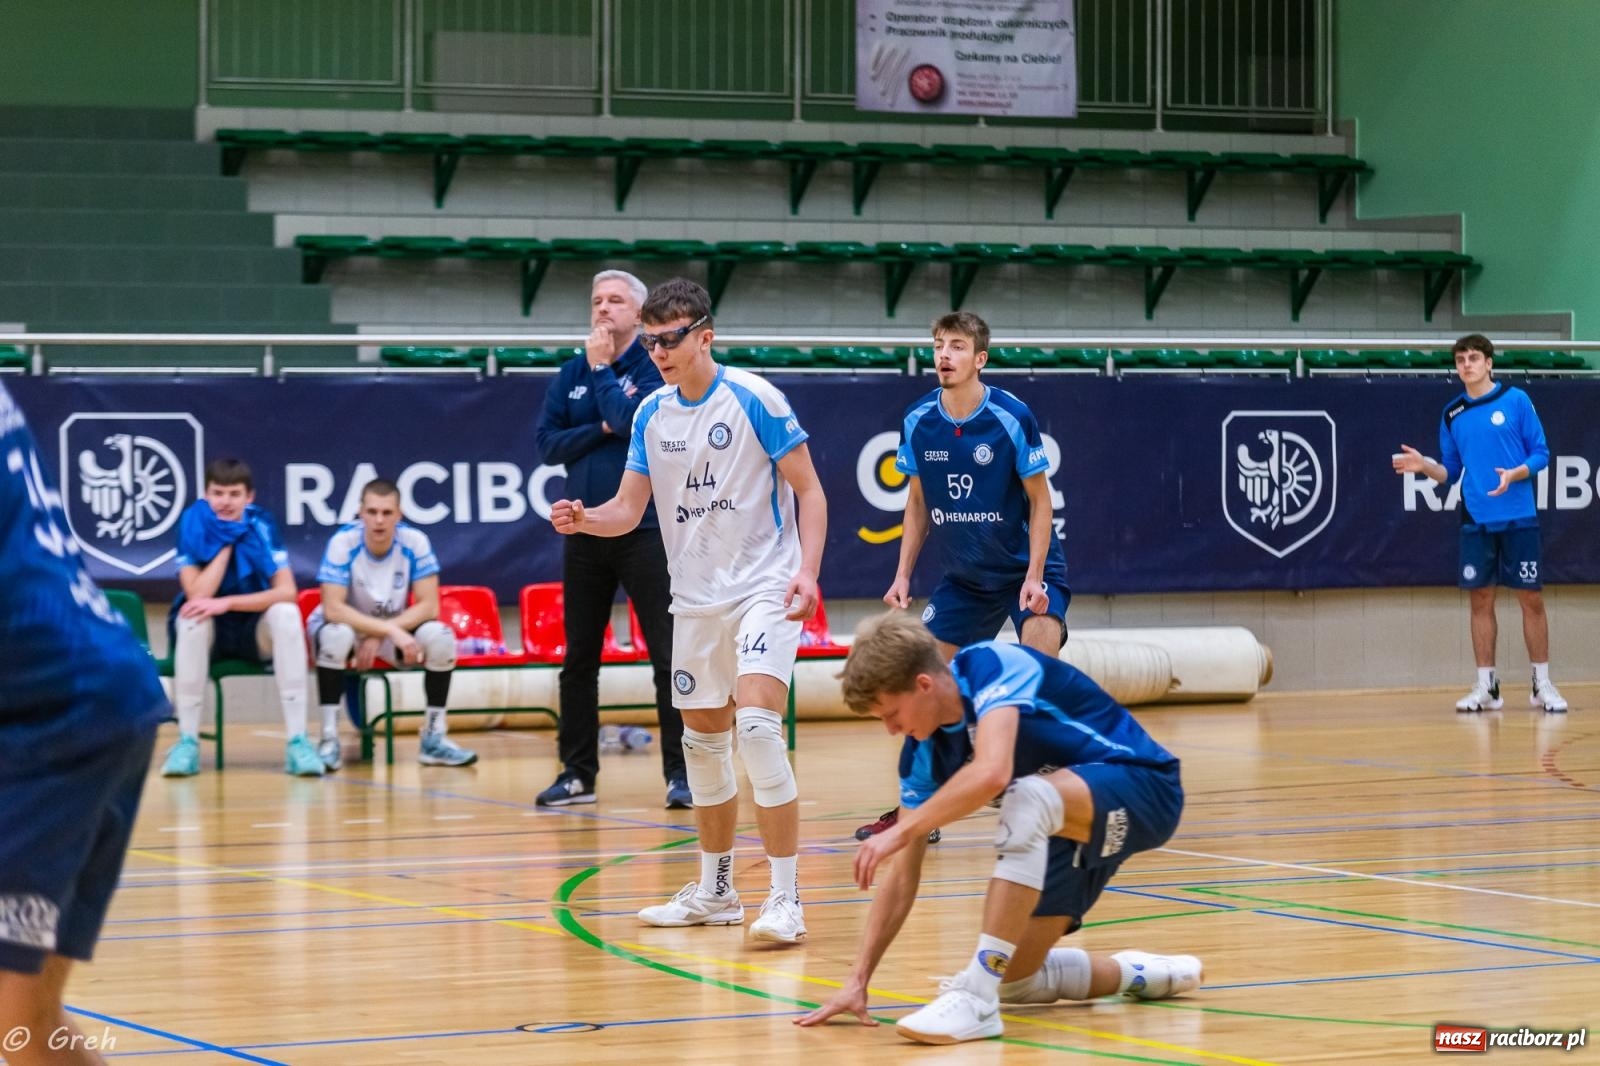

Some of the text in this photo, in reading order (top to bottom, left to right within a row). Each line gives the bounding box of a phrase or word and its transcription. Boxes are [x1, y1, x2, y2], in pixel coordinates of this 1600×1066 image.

[686, 461, 717, 492] 44
[947, 473, 973, 499] 59
[946, 511, 1003, 523] HEMARPOL
[1519, 561, 1538, 579] 33
[741, 632, 768, 655] 44
